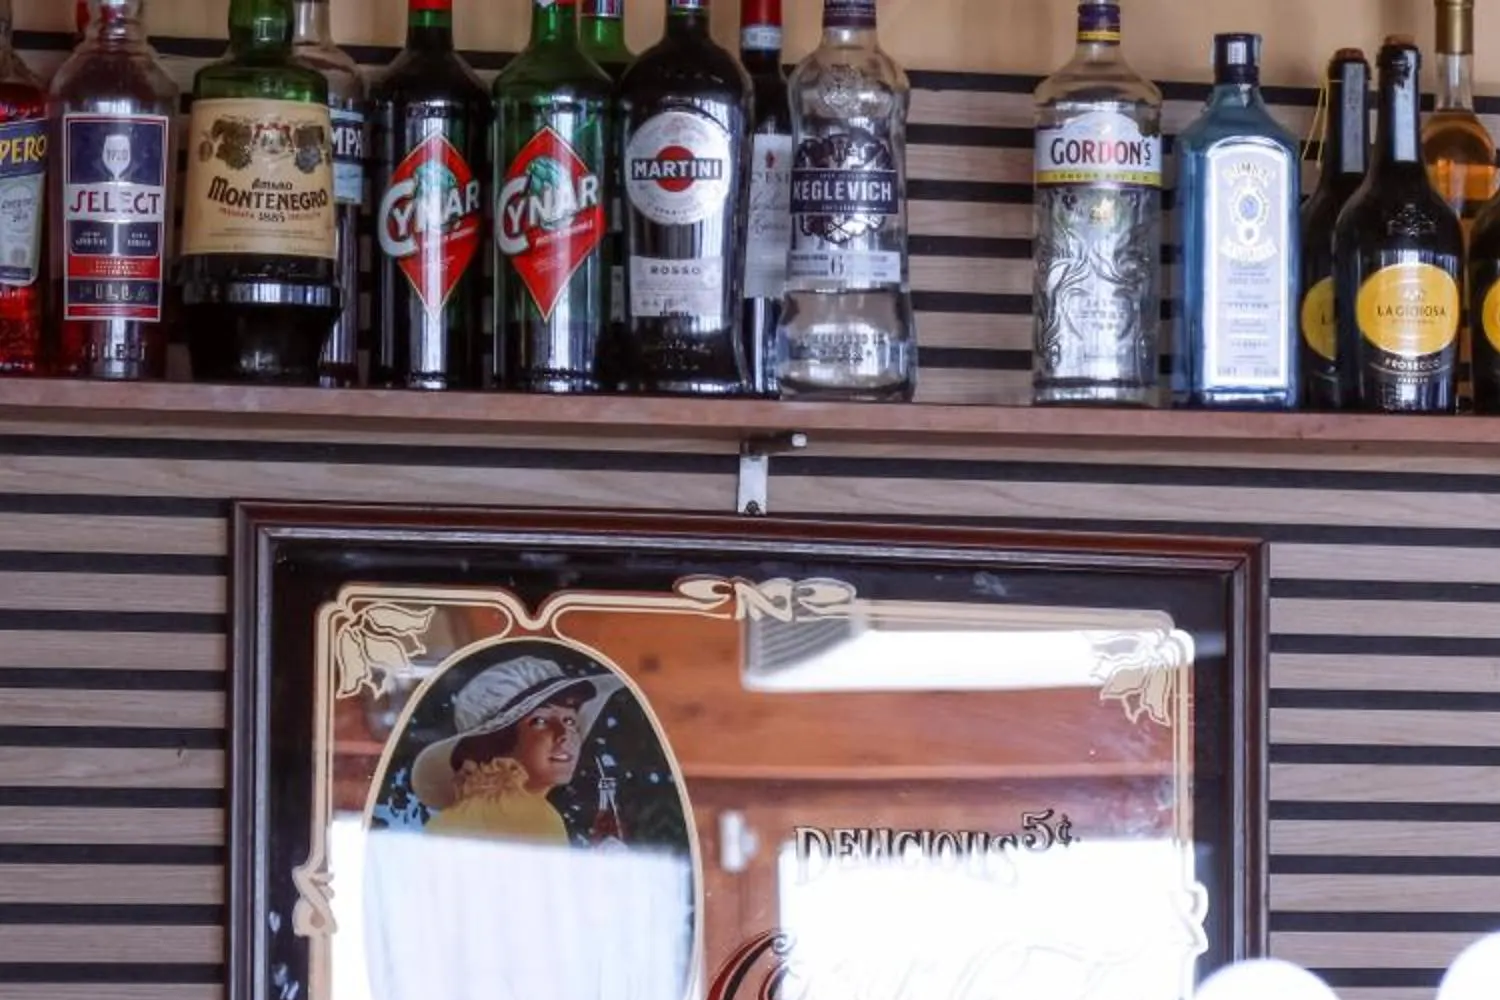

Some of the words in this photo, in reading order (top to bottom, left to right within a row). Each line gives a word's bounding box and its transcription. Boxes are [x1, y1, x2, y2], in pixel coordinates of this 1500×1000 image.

[634, 161, 720, 178] MARTINI
[69, 189, 161, 215] SELECT
[207, 175, 329, 212] MONTENEGRO
[378, 178, 480, 257] CYNAR
[496, 173, 599, 255] CYNAR
